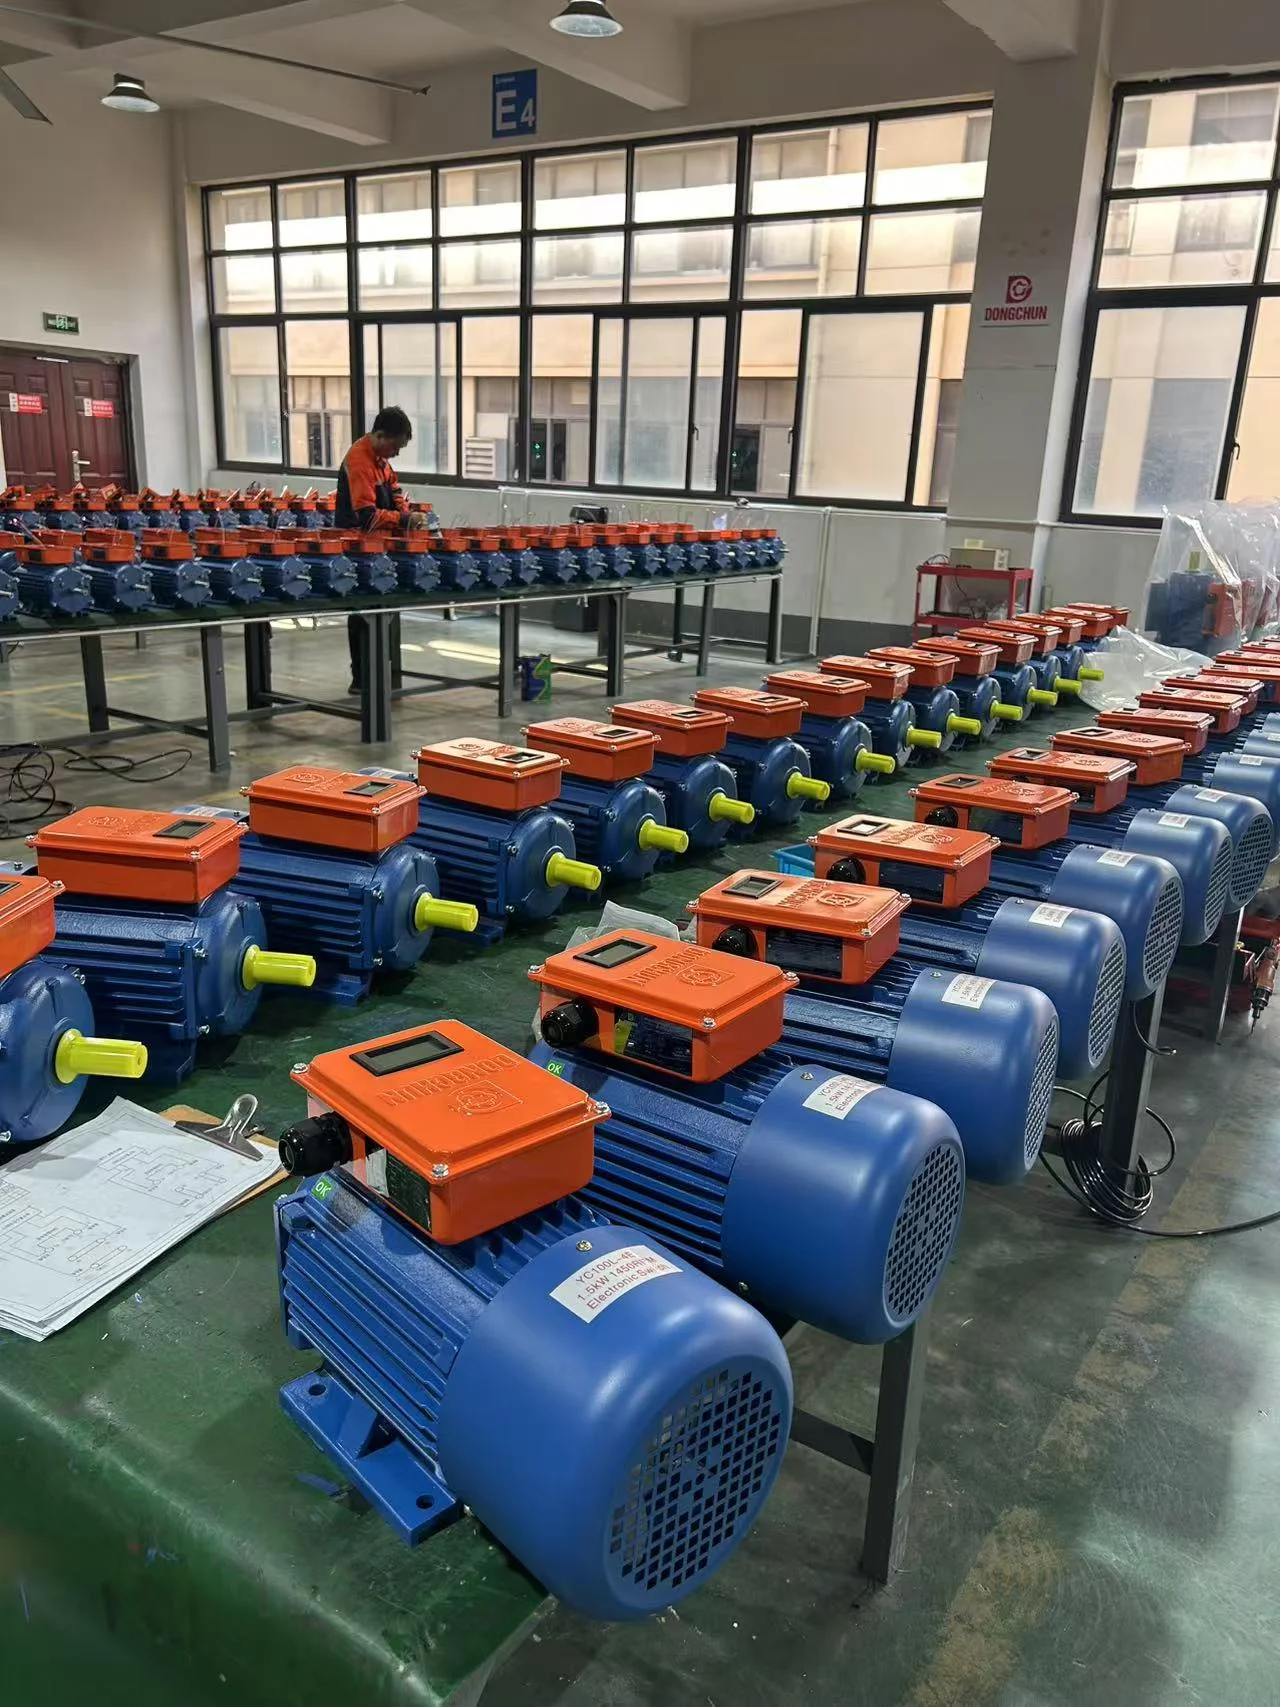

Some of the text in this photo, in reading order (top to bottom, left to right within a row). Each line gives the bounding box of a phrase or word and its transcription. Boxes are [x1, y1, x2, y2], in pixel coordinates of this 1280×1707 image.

[984, 306, 1048, 321] DONGCHUN
[547, 1062, 562, 1074] OK
[315, 1181, 332, 1197] OK
[576, 1252, 634, 1284] YC100L-4E
[577, 1277, 609, 1302] 1.5kW
[587, 1273, 639, 1311] Electronic
